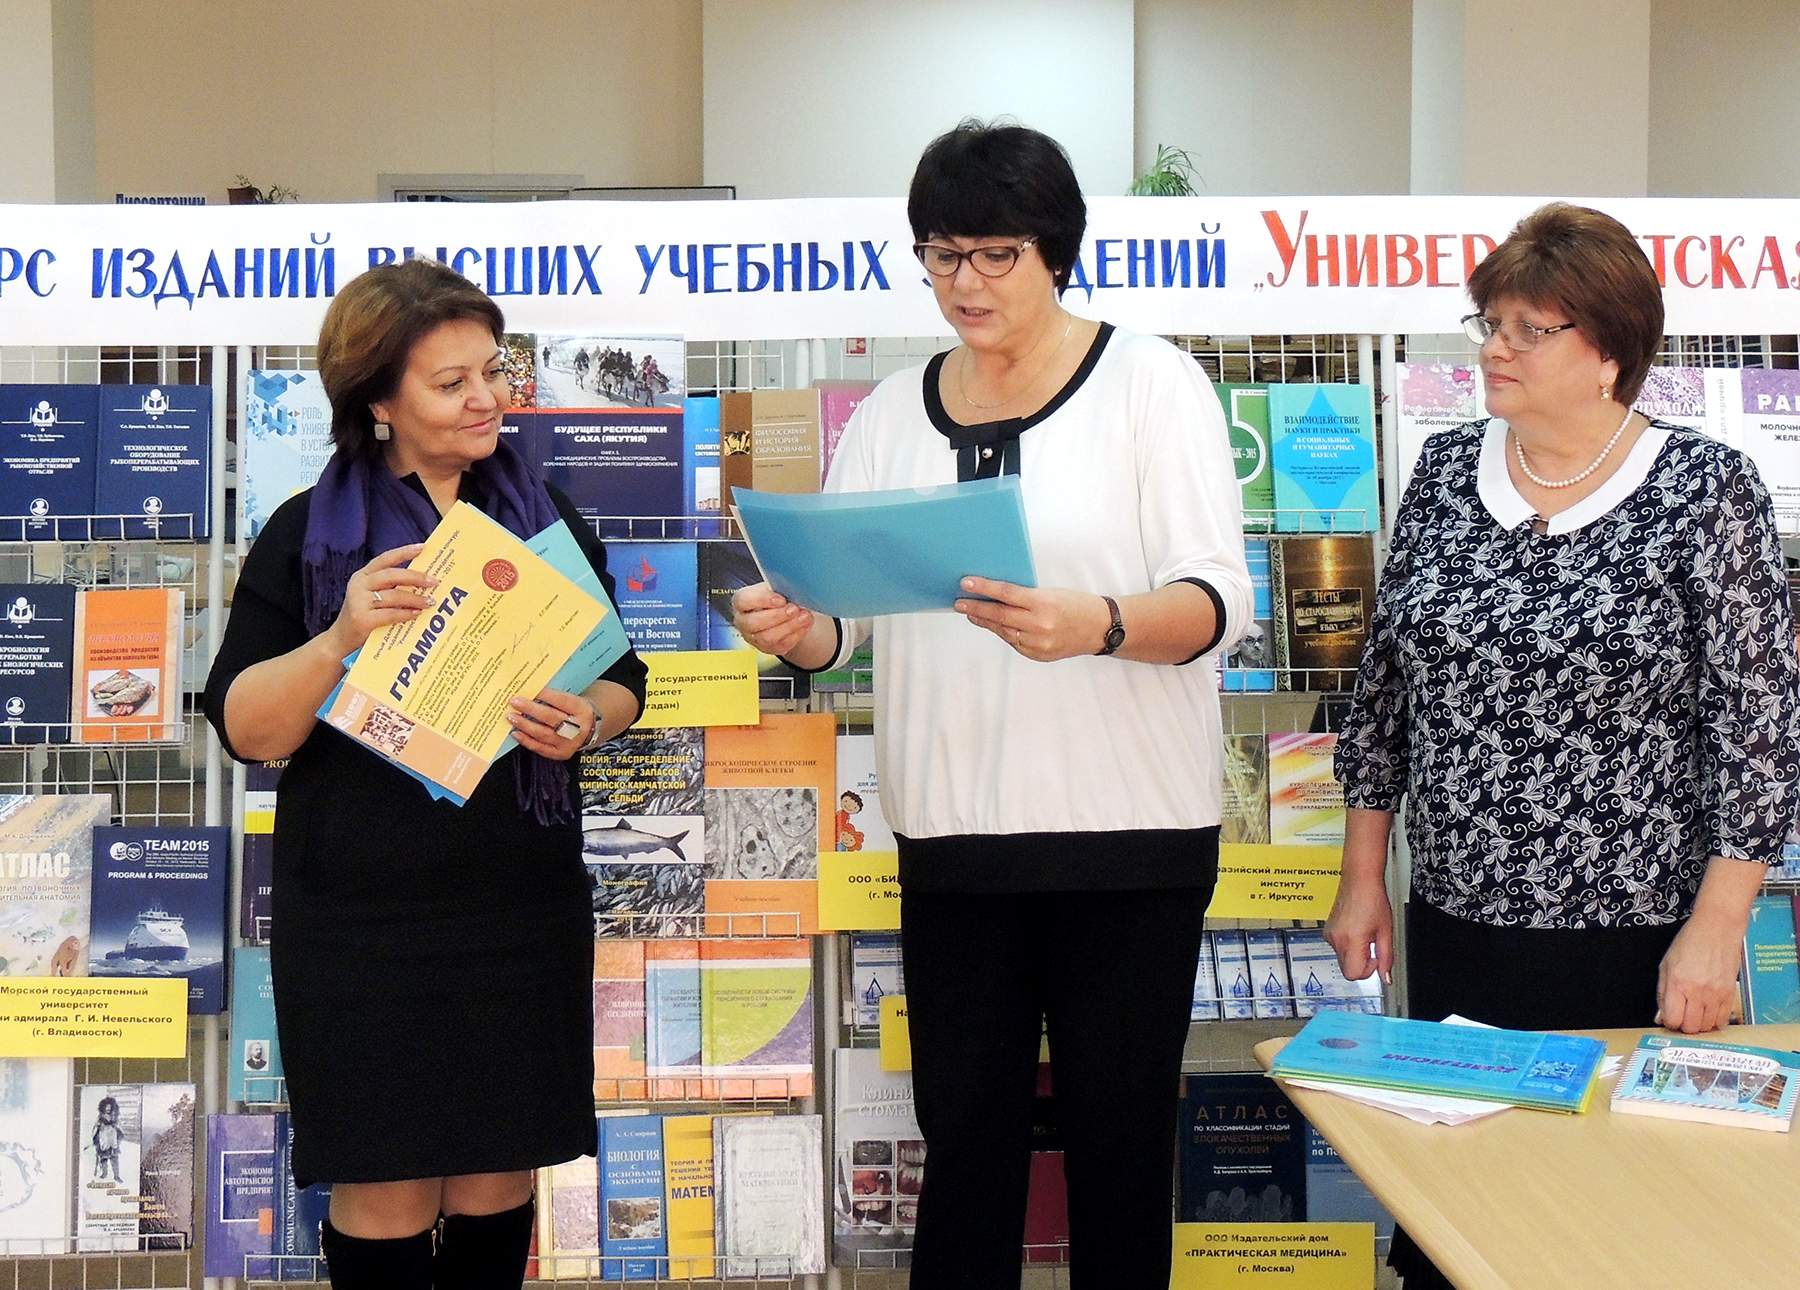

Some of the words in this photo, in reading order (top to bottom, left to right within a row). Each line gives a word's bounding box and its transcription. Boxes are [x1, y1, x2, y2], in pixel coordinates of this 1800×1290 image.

[91, 232, 336, 311] ИЗДАНИЙ
[635, 240, 891, 295] УЧЕБНЫХ
[1758, 394, 1800, 411] РА
[301, 407, 322, 419] РОЛЬ
[1284, 415, 1360, 425] ВЗАИМОДЕЙСТВИЕ
[554, 426, 601, 434] БУДУЩЕЕ
[574, 435, 600, 443] САХА
[602, 435, 648, 444] (ЯКУТИЯ)
[498, 569, 515, 590] 2015
[646, 629, 680, 639] Востока
[389, 585, 470, 702] ГРАМОТА
[655, 672, 748, 685] государственный
[647, 688, 682, 698] рситет
[646, 701, 680, 711] гадан)
[617, 755, 691, 764] РАСПРЕДЕЛЕНИЕ
[583, 769, 636, 777] СОСТОЯНИЕ
[640, 768, 681, 777] ЗАПАСОВ
[609, 794, 644, 803] СЕЛЬДИ
[144, 839, 180, 851] TEAM
[182, 840, 209, 851] 2015
[0, 852, 70, 878] ТЛАС
[154, 872, 208, 880] PROCEEDINGS
[1216, 865, 1271, 877] разийский
[875, 875, 900, 884] «БИ
[1260, 880, 1305, 889] институт
[1269, 892, 1314, 902] Иркутске
[52, 985, 148, 996] государственный
[40, 1001, 109, 1011] университет
[13, 1014, 68, 1024] адмирала
[74, 1014, 84, 1023] Г.
[87, 1014, 98, 1023] И.
[102, 1014, 173, 1024] Невельского
[32, 1027, 44, 1037] (г.
[47, 1027, 123, 1037] Владивосток)
[862, 1084, 914, 1100] Клини
[858, 1104, 915, 1118] стома
[1196, 1105, 1288, 1120] АТЛАС
[607, 1150, 660, 1162] БИОЛОГИЯ
[608, 1170, 660, 1178] ОСНОВАМИ
[1205, 1234, 1228, 1242] ООО
[1231, 1233, 1306, 1243] Издательский
[1308, 1235, 1329, 1243] дом
[1185, 1249, 1279, 1257] «ПРАКТИЧЕСКАЯ
[1280, 1249, 1347, 1258] МЕДИЦИНА»
[1238, 1265, 1249, 1274] (г.
[1252, 1265, 1295, 1273] Москва)
